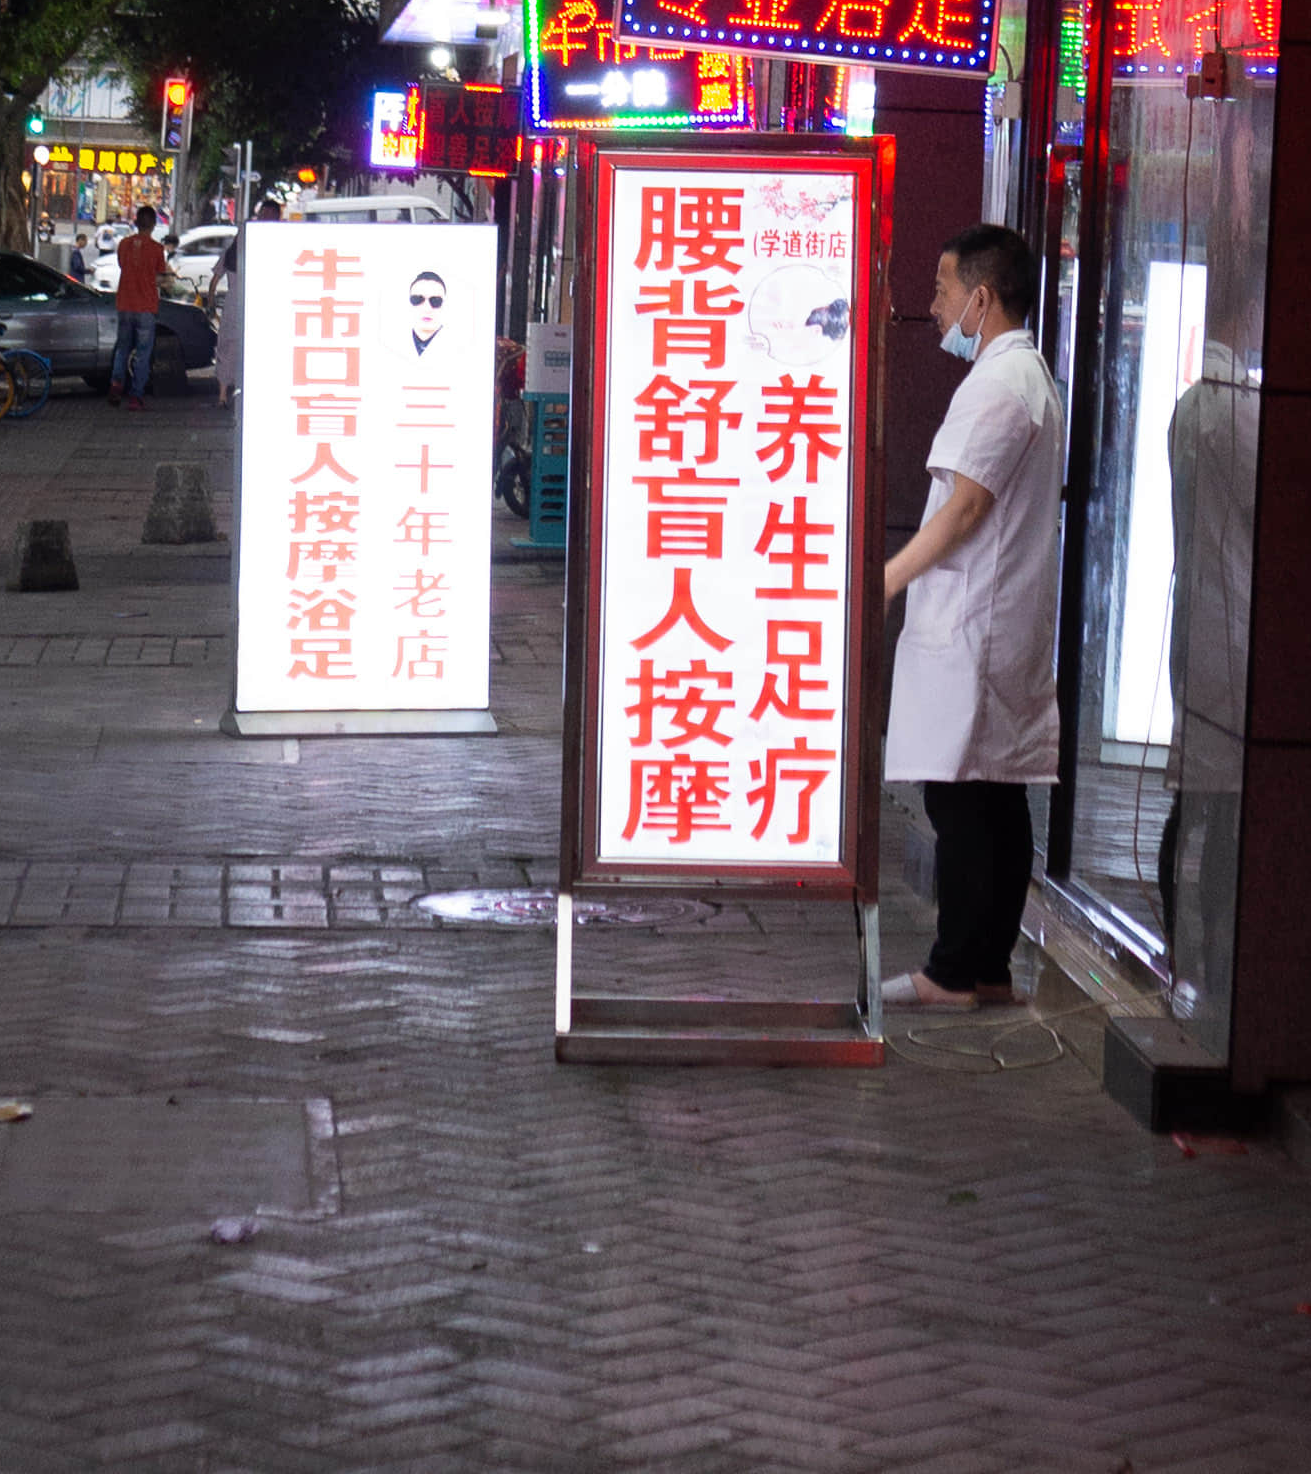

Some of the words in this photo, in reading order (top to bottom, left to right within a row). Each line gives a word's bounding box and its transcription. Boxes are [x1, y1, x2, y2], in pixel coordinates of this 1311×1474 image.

[283, 248, 364, 683] 牛市口盲人按摩浴足
[391, 384, 457, 683] 三十年老店
[621, 184, 746, 848] 腰背舒盲人按摩
[746, 370, 842, 848] 养生足疗
